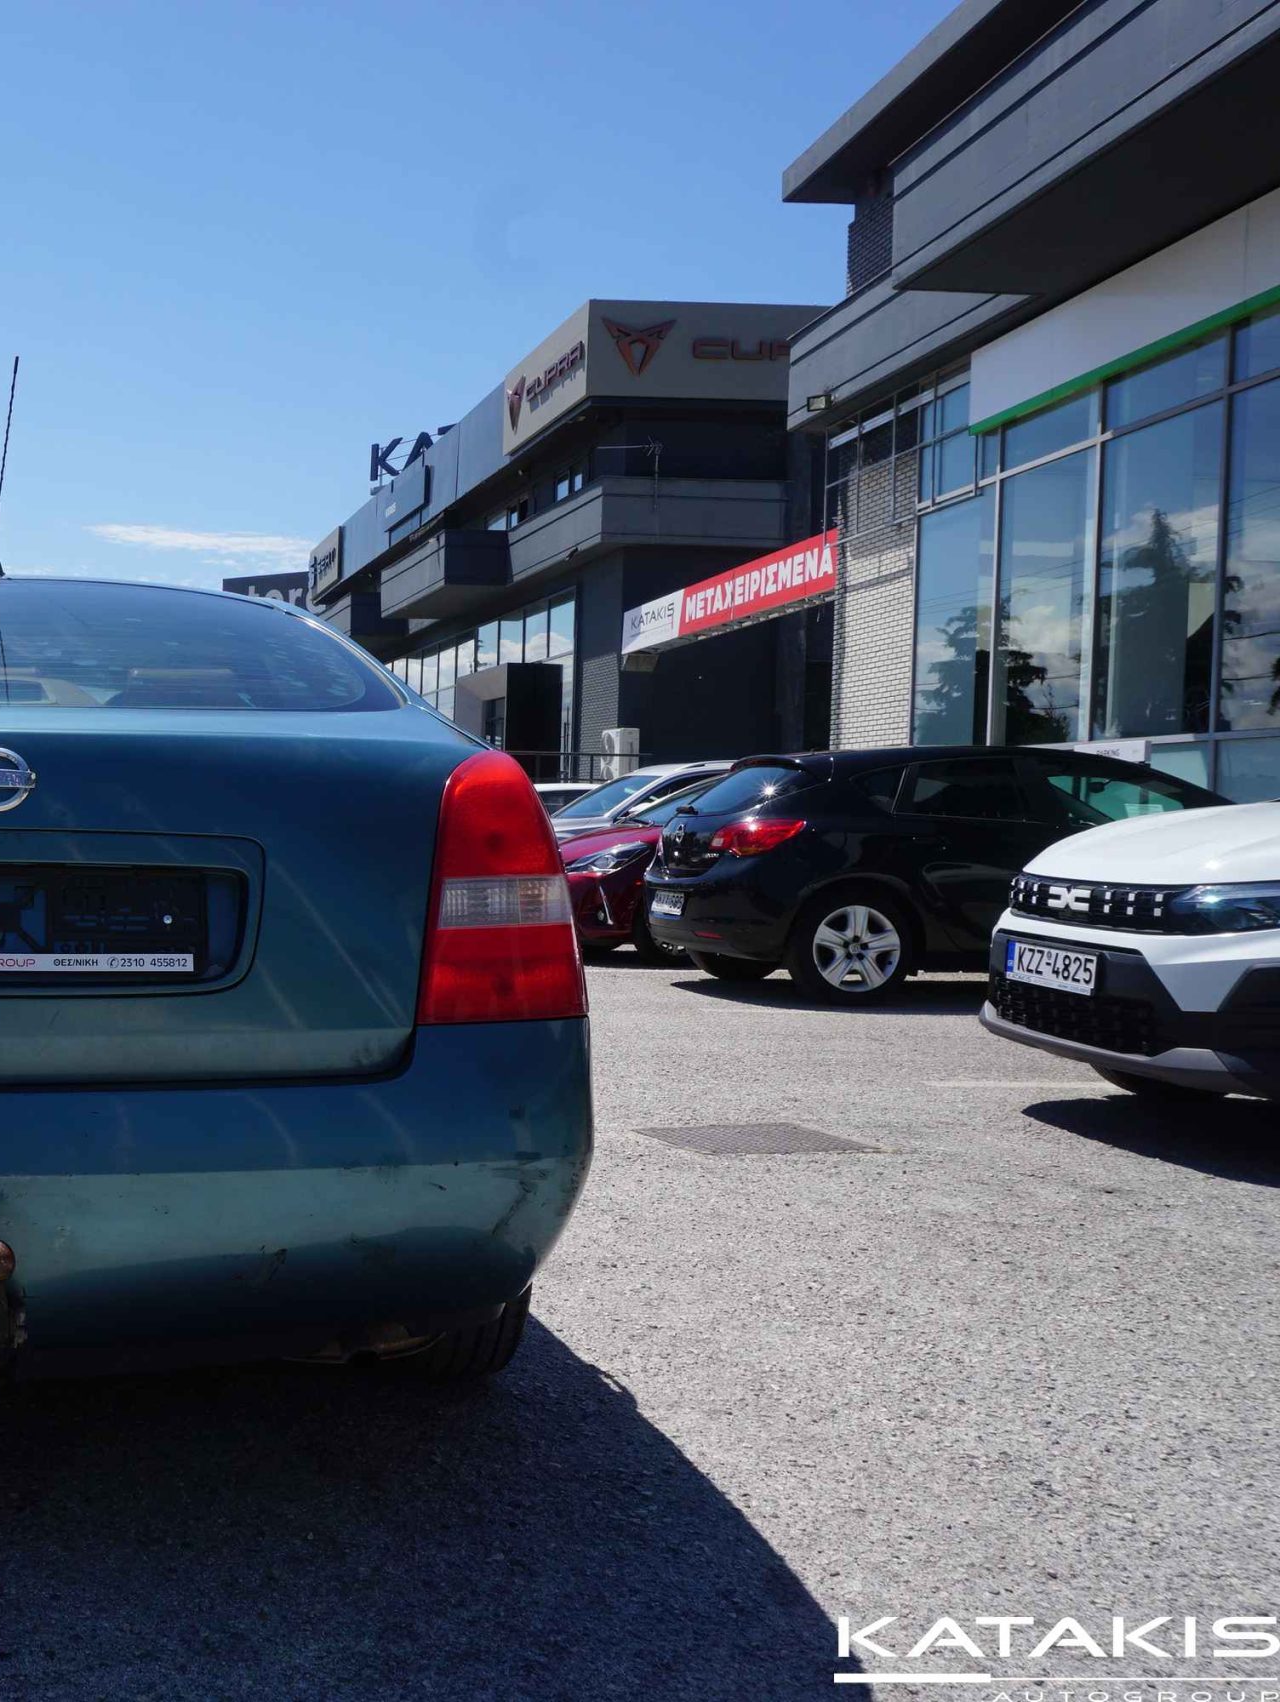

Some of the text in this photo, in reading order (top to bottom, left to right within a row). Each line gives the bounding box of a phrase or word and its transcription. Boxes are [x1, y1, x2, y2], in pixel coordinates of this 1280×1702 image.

[526, 340, 584, 401] CUPRA
[630, 602, 675, 630] KATAKIS
[120, 957, 145, 968] 2310
[150, 957, 188, 968] 455812
[1017, 946, 1095, 985] KZZ-4825
